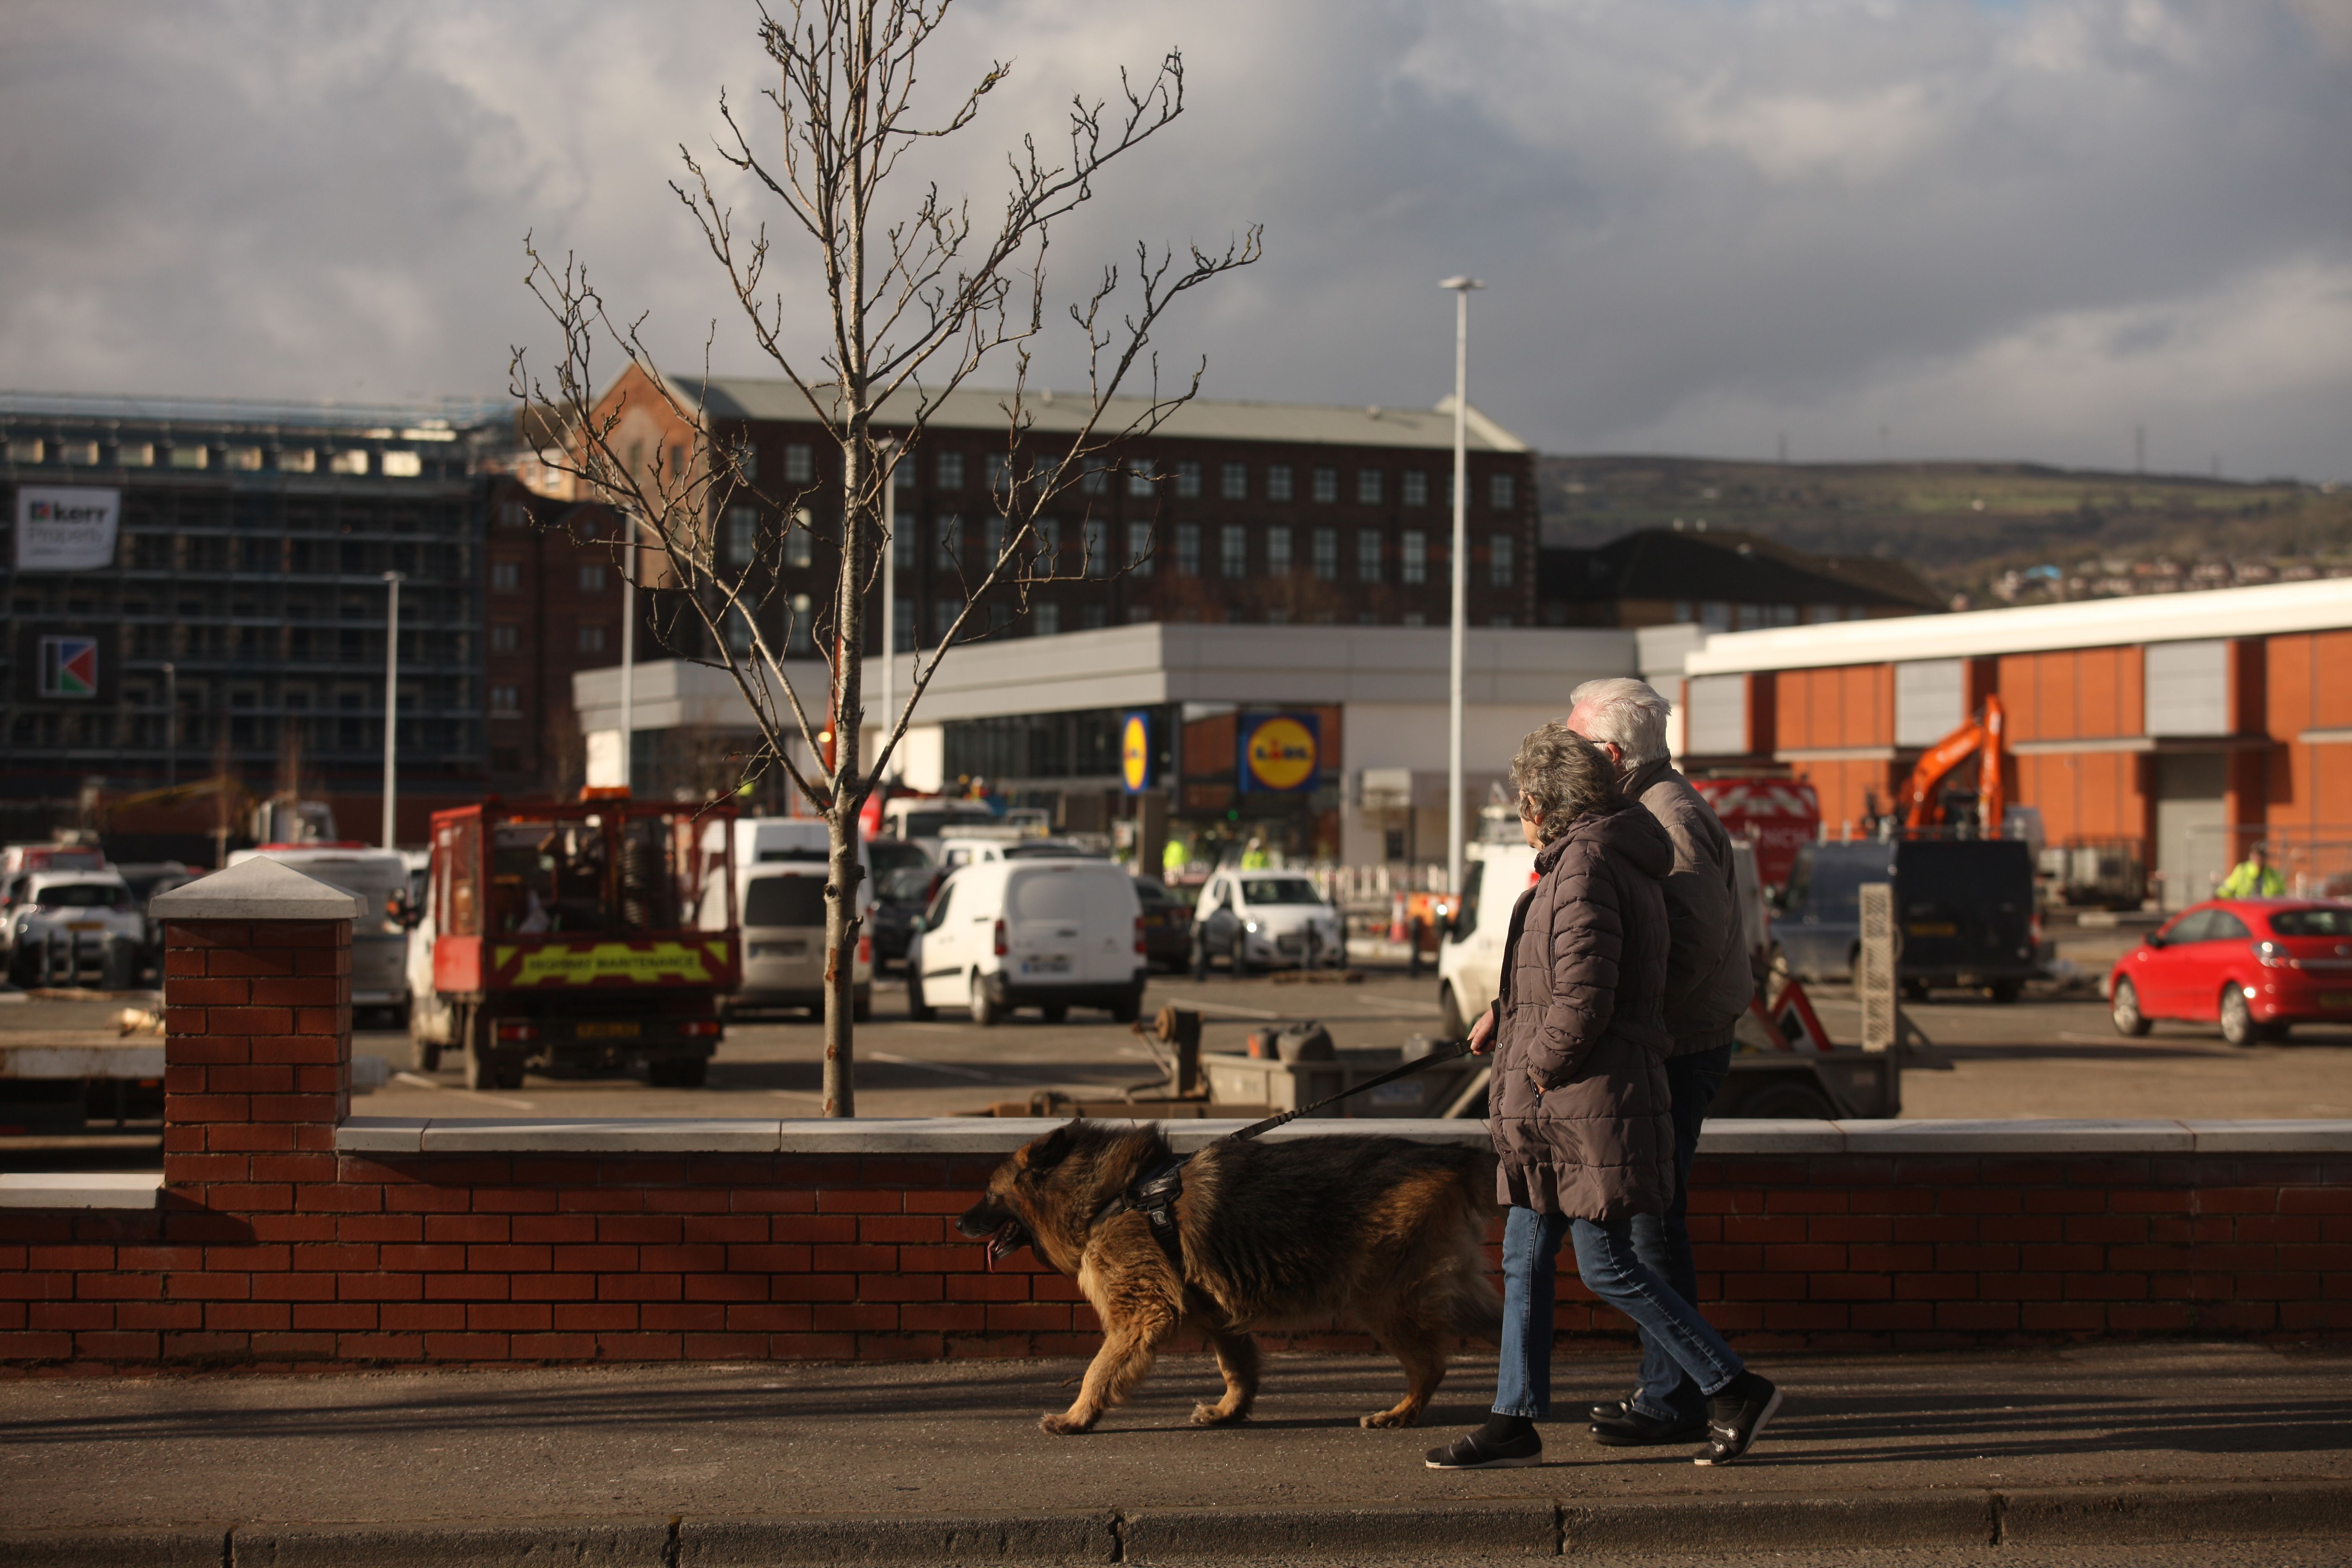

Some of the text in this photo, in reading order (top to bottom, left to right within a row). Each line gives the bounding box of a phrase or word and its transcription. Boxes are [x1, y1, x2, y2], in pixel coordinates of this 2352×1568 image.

[53, 501, 108, 522] kerr
[529, 954, 695, 970] HIGHWAY MAINTENANCE
